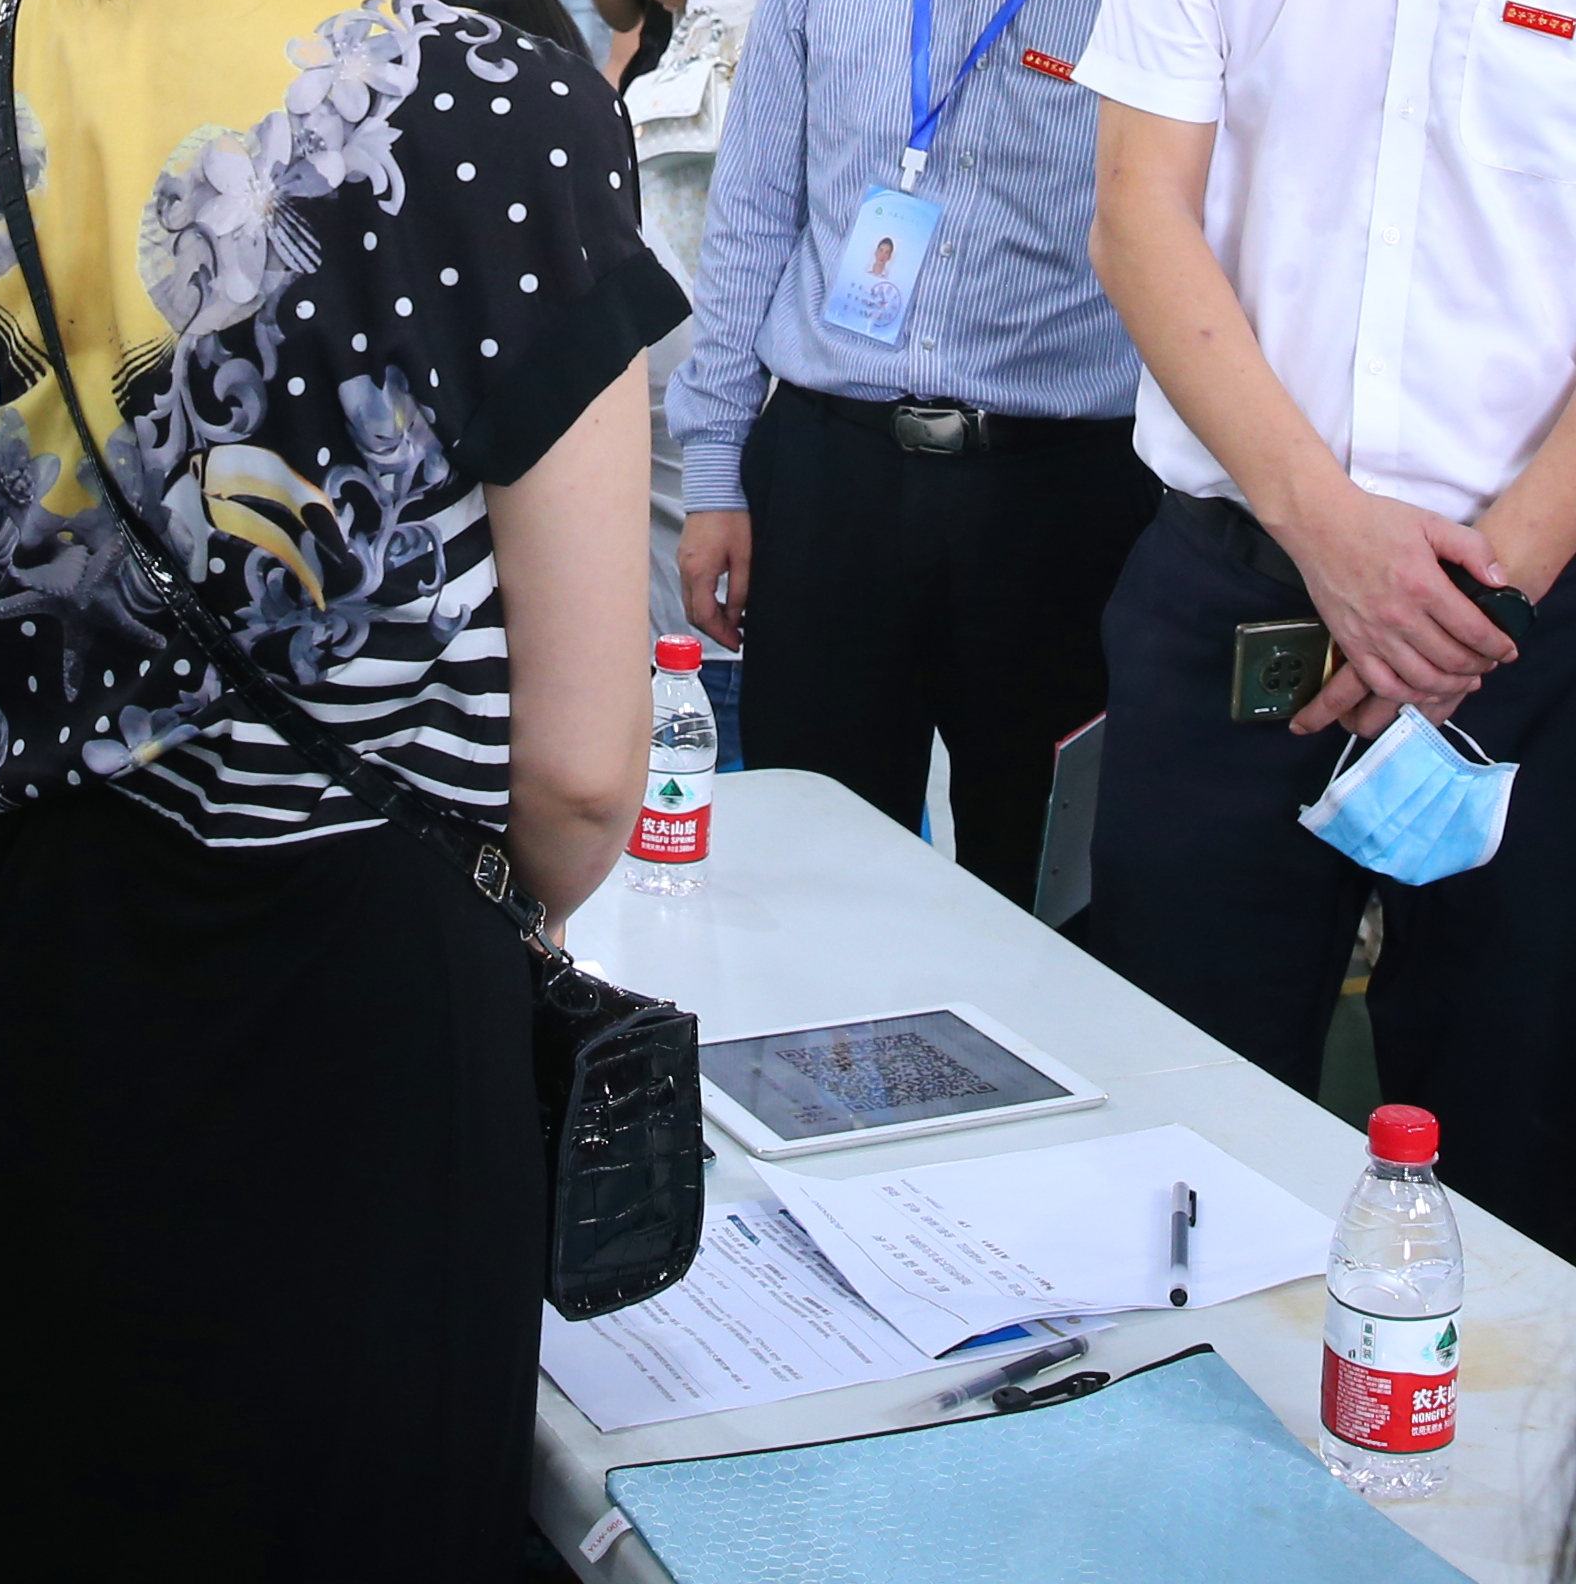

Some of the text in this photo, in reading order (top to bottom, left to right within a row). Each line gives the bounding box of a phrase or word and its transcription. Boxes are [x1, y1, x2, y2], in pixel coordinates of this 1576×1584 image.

[642, 817, 698, 836] 农夫山泉
[1411, 1406, 1447, 1424] NONGFU
